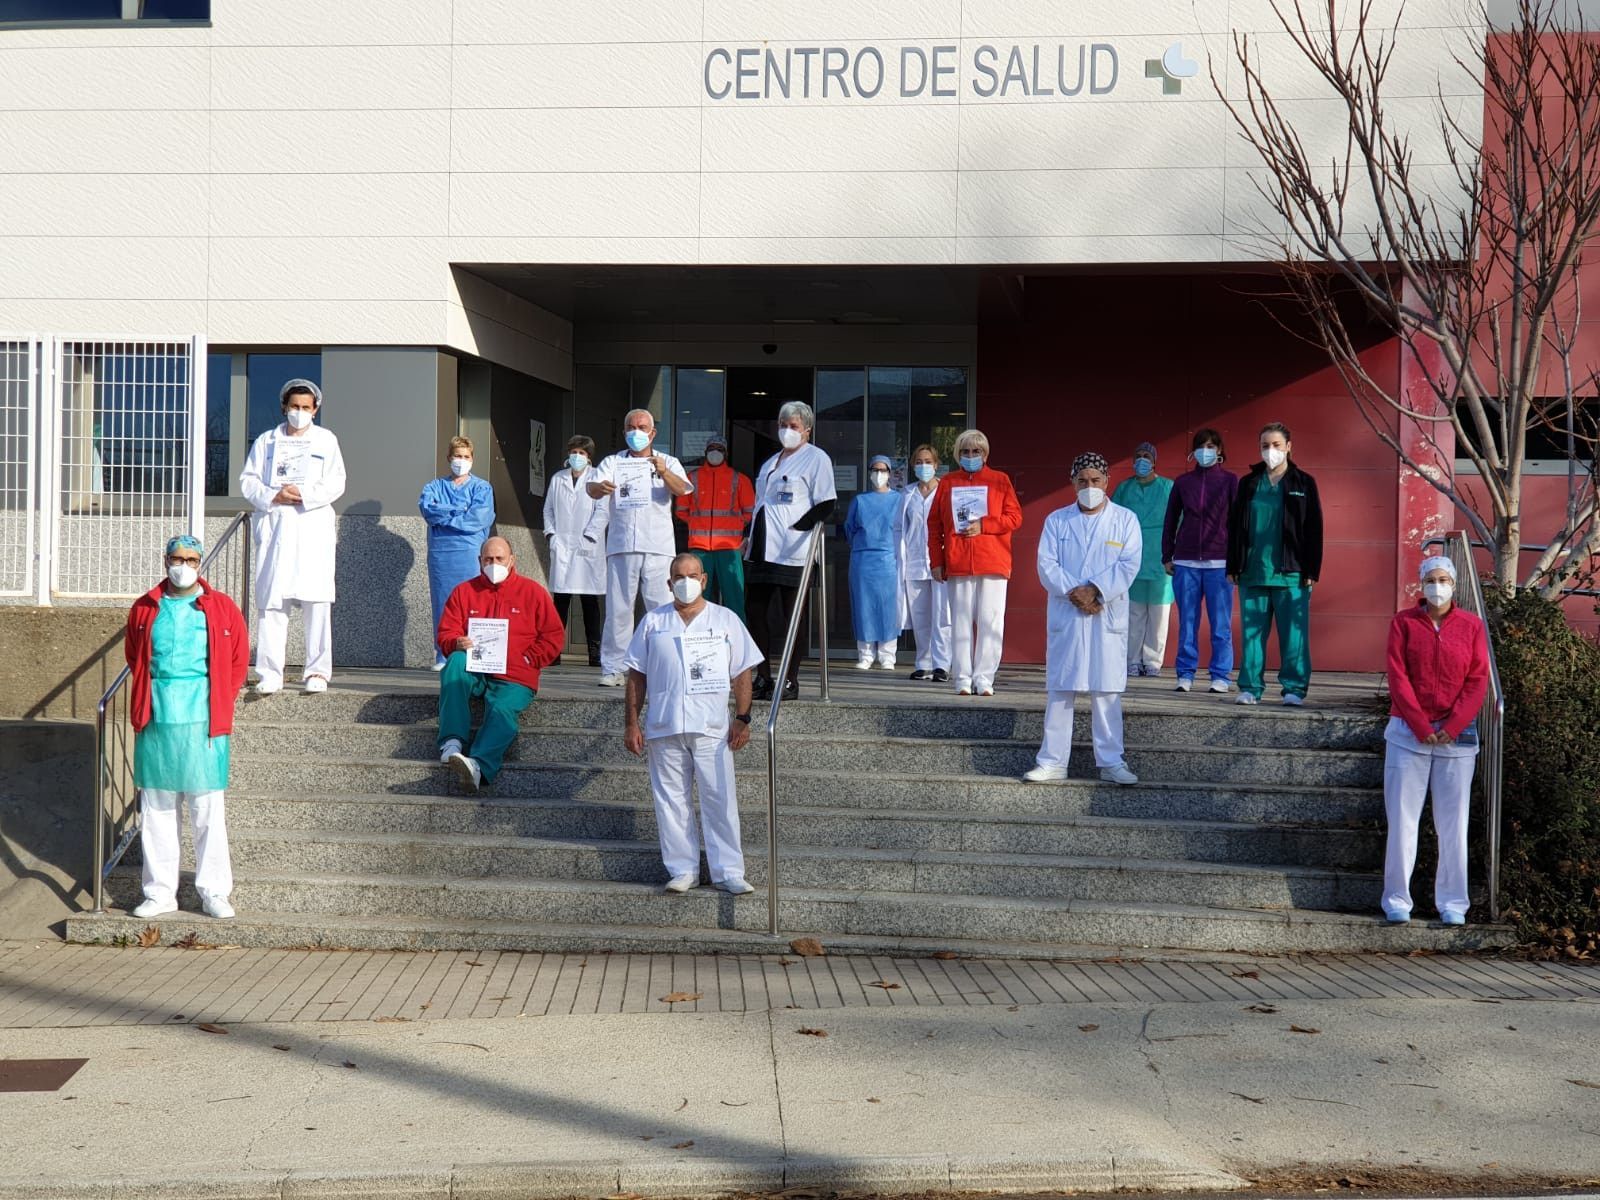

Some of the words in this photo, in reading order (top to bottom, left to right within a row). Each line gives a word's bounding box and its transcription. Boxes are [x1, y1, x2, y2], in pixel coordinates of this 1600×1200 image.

[704, 46, 885, 100] CENTRO
[900, 45, 957, 98] DE
[972, 43, 1119, 97] SALUD
